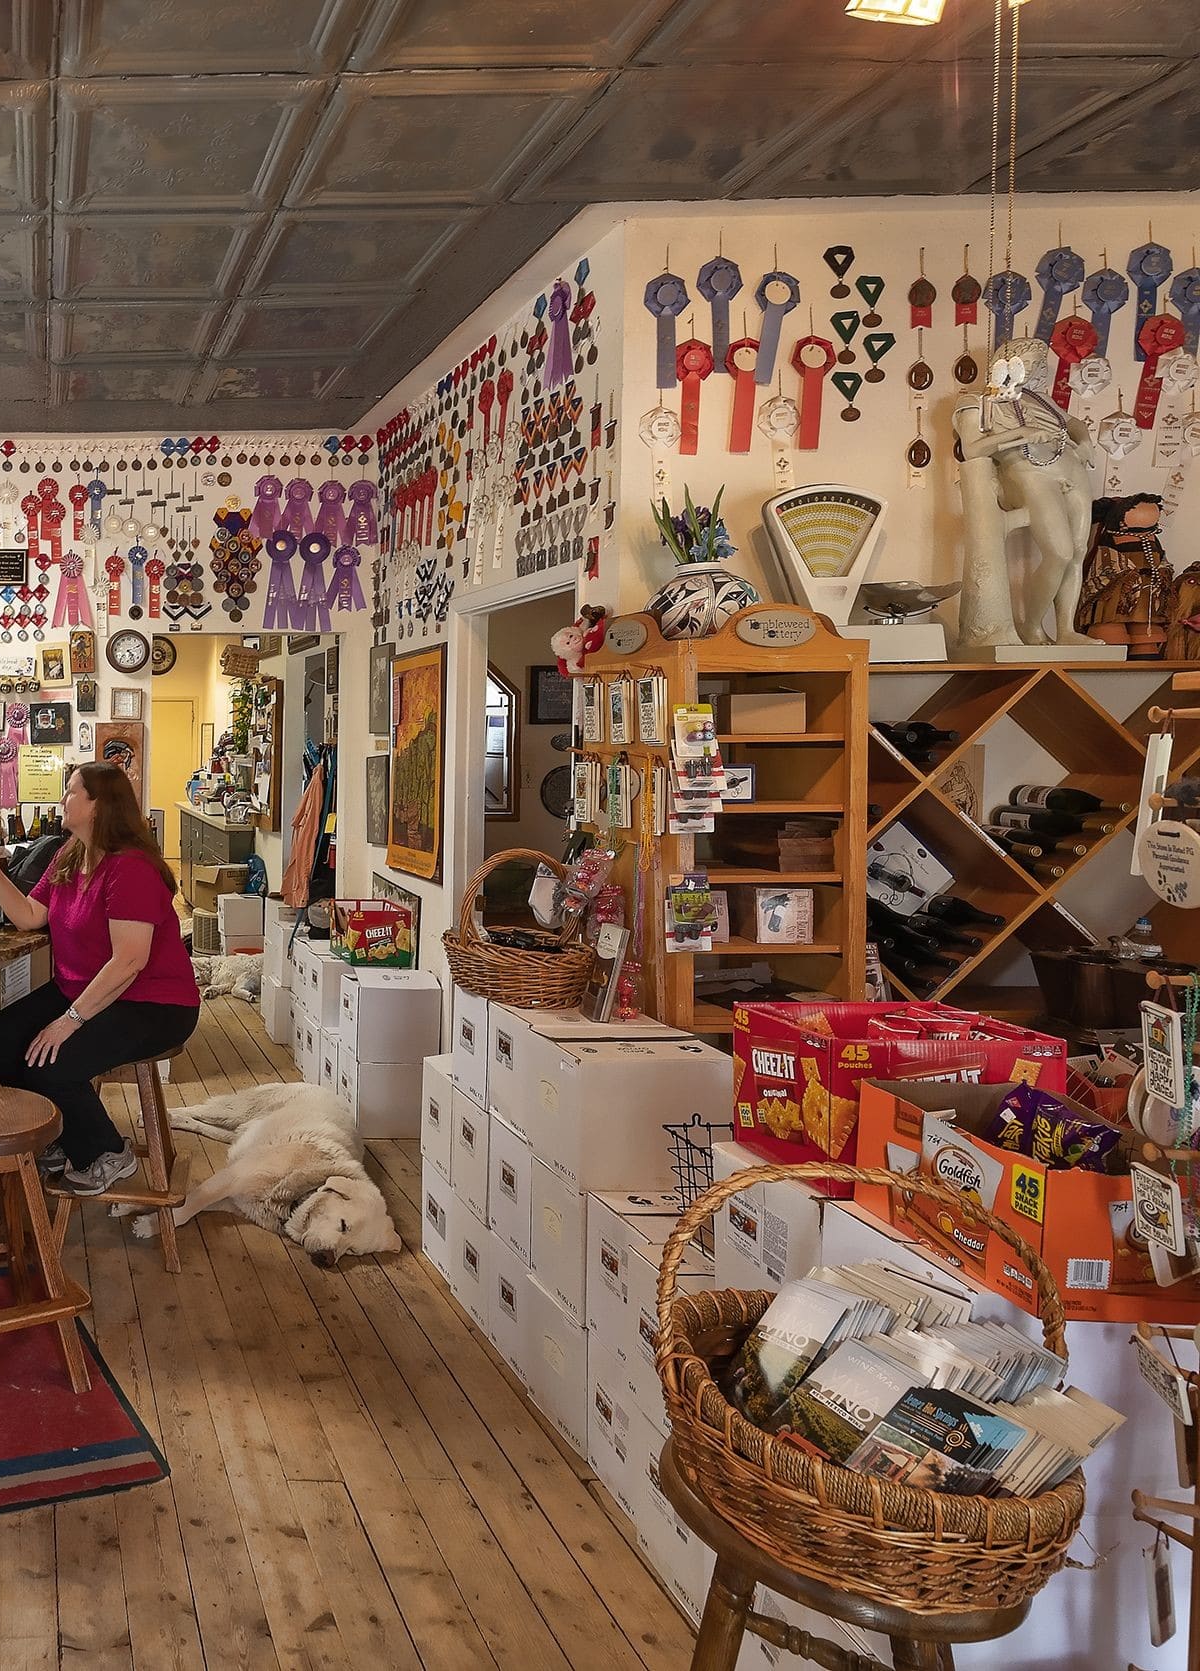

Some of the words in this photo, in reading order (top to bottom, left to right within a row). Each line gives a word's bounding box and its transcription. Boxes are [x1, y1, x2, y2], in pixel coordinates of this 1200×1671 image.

[734, 1007, 749, 1025] 45
[840, 1044, 870, 1062] 45
[837, 1061, 873, 1070] Pouches
[938, 1157, 983, 1190] Goldfish
[1015, 1172, 1040, 1199] 45
[1014, 1192, 1039, 1210] SNACK
[1014, 1201, 1039, 1220] PACKS
[953, 1228, 985, 1251] Cheddar
[818, 1384, 875, 1423] VINO
